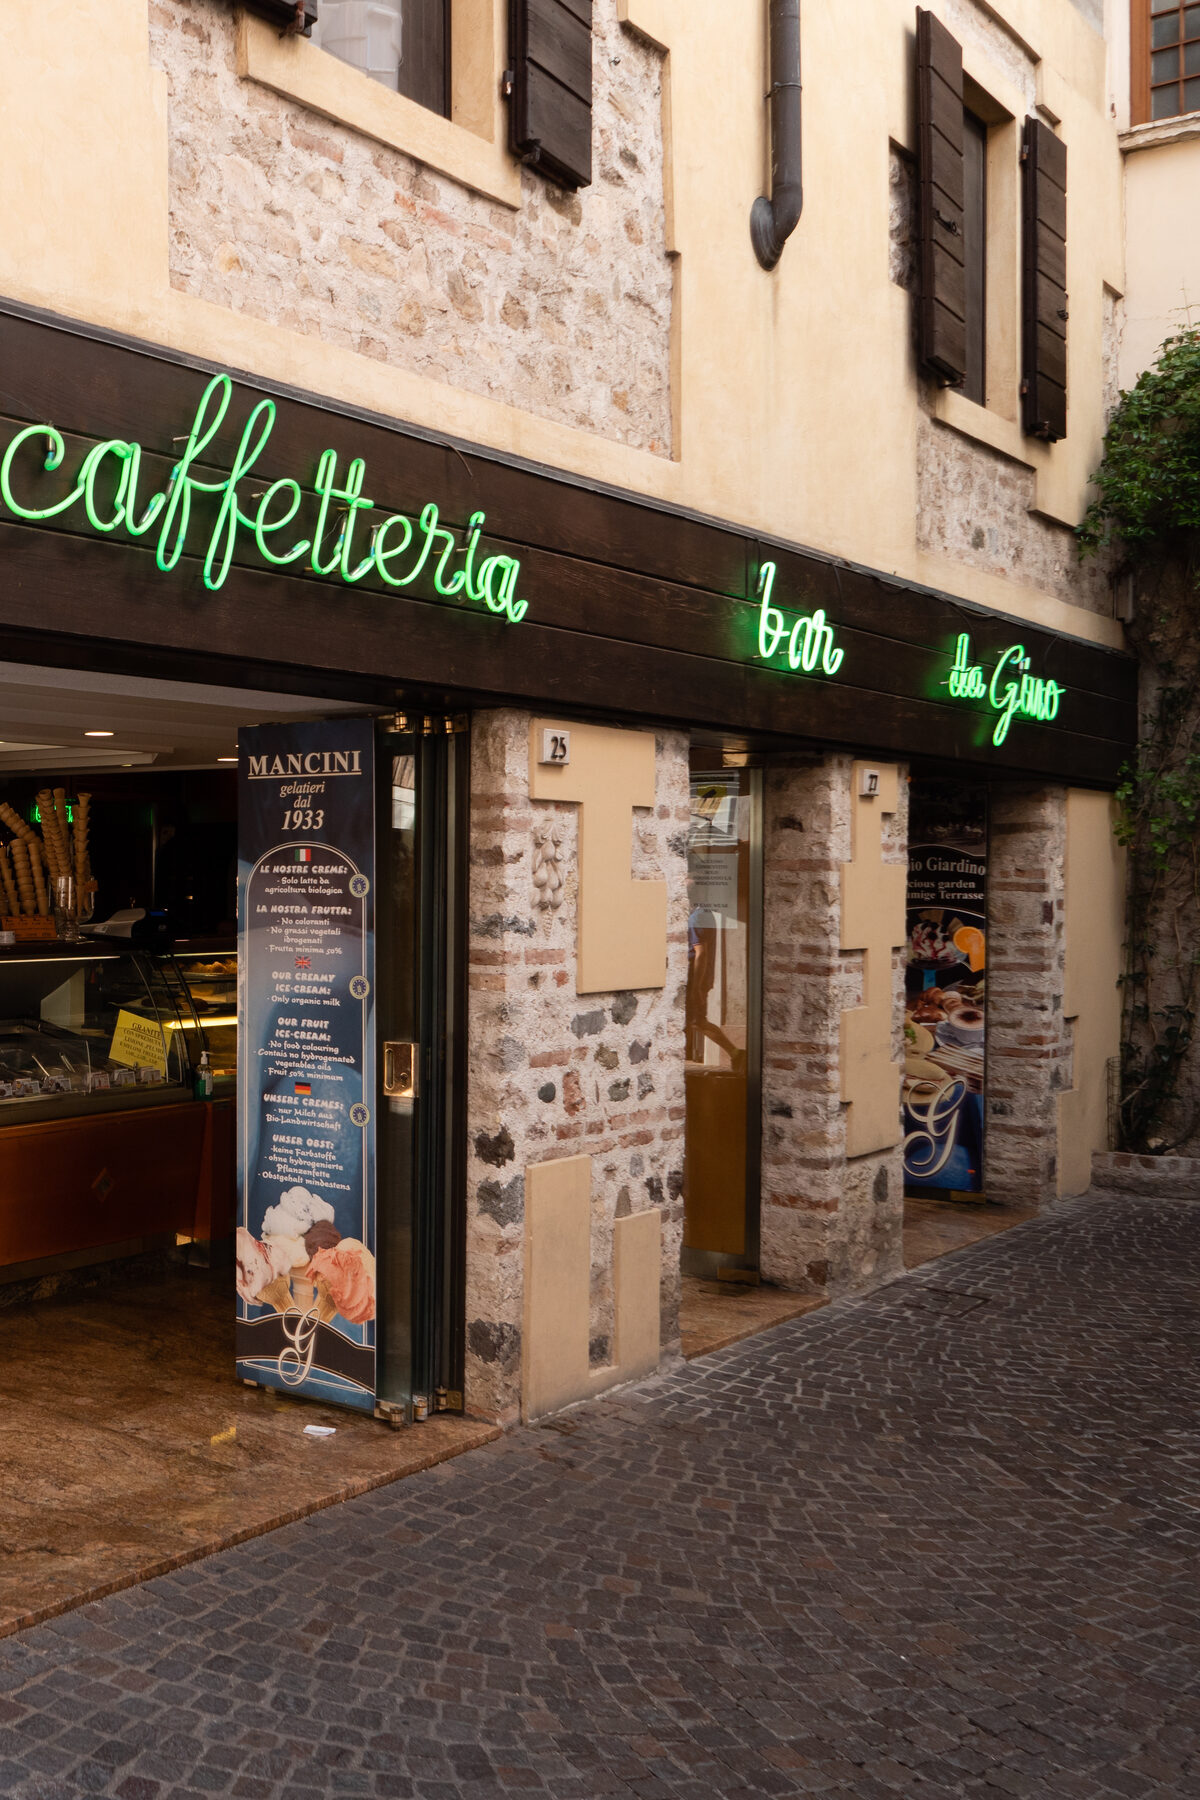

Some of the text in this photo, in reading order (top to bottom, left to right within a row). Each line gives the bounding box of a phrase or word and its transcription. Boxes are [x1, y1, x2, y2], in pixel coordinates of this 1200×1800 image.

[1, 374, 528, 623] caffetteria
[759, 562, 843, 675] bar
[950, 633, 1066, 746] da Gino
[551, 736, 567, 759] 25
[248, 751, 361, 775] MANCINI
[280, 781, 325, 798] gelatieri
[294, 796, 310, 809] dal
[281, 810, 323, 830] 1933
[312, 866, 348, 874] CREME:
[926, 857, 986, 875] Giardino
[265, 886, 343, 895] agricoltura biologica
[908, 880, 975, 890] cious garden
[940, 891, 984, 899] Terrasse
[271, 905, 307, 914] NOSTRA
[311, 906, 352, 915] FRUTTA:
[285, 927, 307, 935] grassi
[310, 928, 340, 936] vegetali
[284, 936, 322, 945] idrogenati
[326, 947, 342, 955] 50%
[272, 971, 336, 982] OUR CREAMY
[276, 984, 331, 995] ICE-CREAM:
[271, 995, 289, 1003] Only
[323, 998, 340, 1006] milk
[278, 1017, 329, 1029] OUR FRUIT
[276, 1030, 331, 1041] ICE-CREAM:
[284, 1041, 300, 1049] food
[302, 1044, 339, 1054] colouring
[301, 1052, 355, 1064] hydrogenated
[276, 1060, 315, 1070] vegetables
[268, 1067, 287, 1075] Fruit
[307, 1072, 343, 1080] minimum
[264, 1094, 344, 1110] UNSERE CREMES:
[294, 1108, 316, 1117] Milch
[273, 1134, 334, 1149] UNSER OBST:
[295, 1149, 336, 1161] Farbstoffe
[269, 1154, 343, 1170] ohne hydrogenierte
[276, 1164, 330, 1178] Pflanzenfette
[262, 1171, 350, 1190] Obstgehalt mindestens
